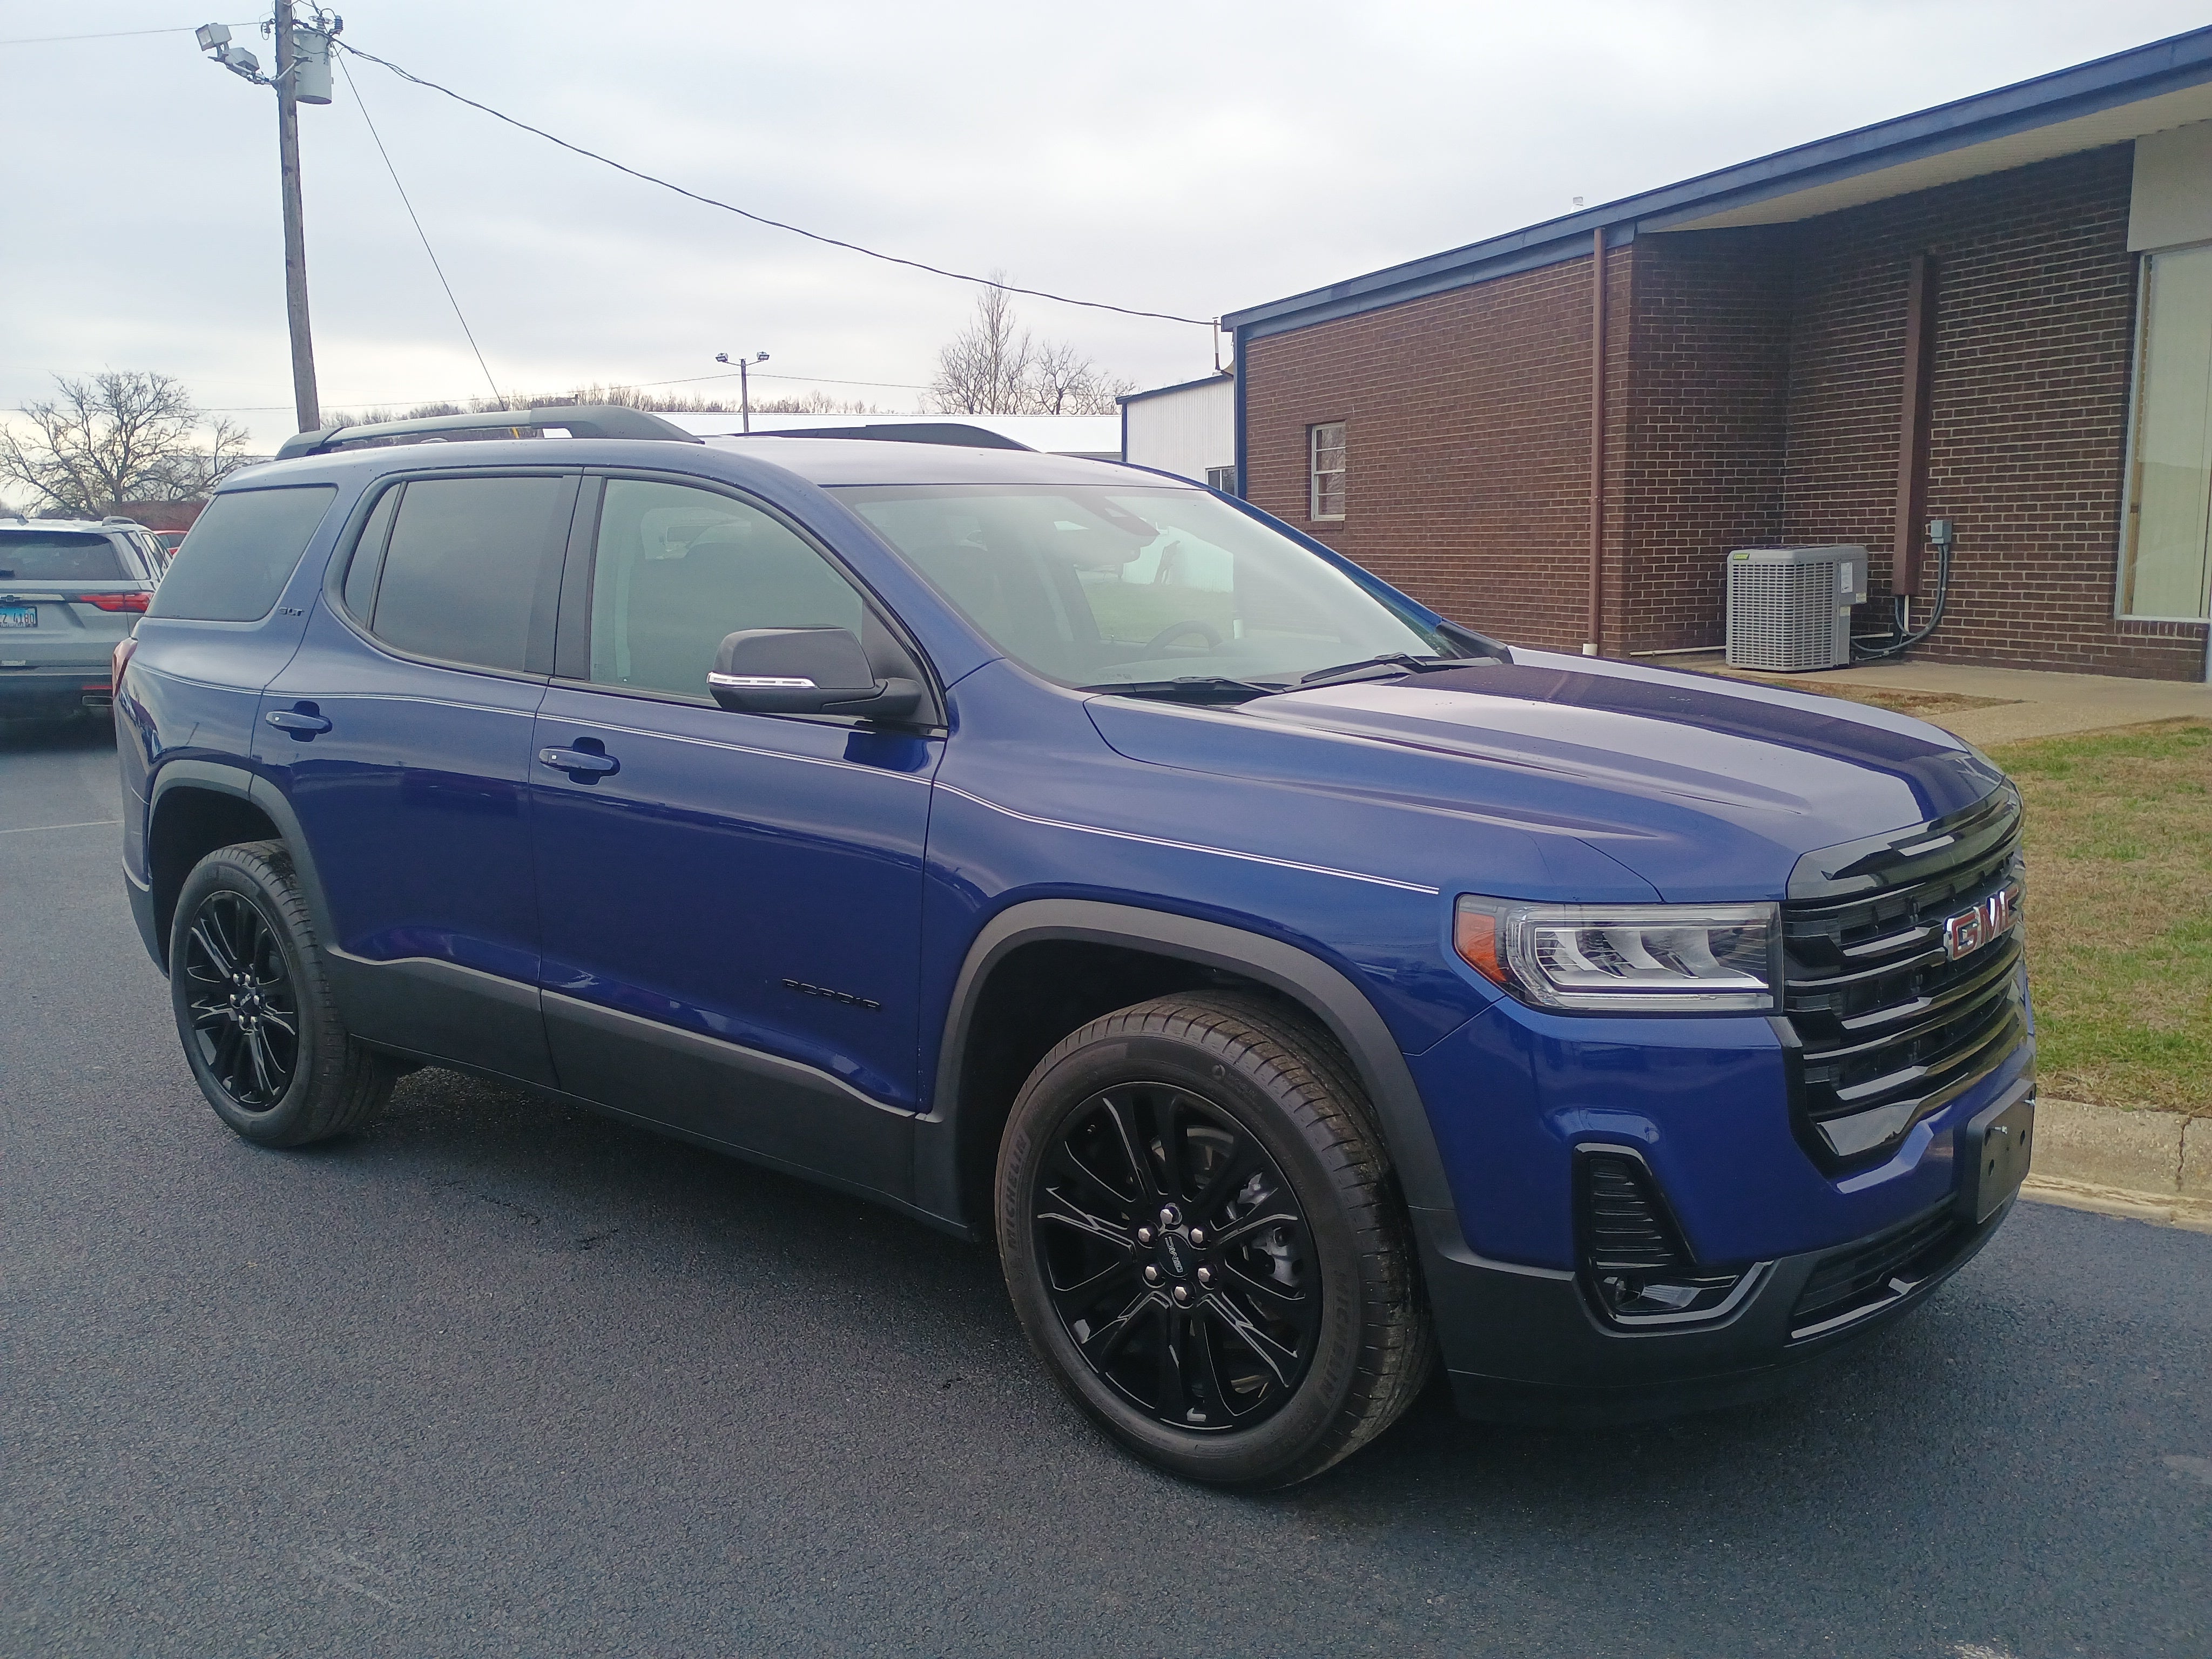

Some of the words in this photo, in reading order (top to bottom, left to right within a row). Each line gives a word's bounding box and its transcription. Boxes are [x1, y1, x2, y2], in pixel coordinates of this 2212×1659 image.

[14, 613, 34, 623] 4180
[1944, 886, 2019, 960] GMC
[1004, 1133, 1028, 1251] MICHELIN
[1164, 1236, 1184, 1273] GMC
